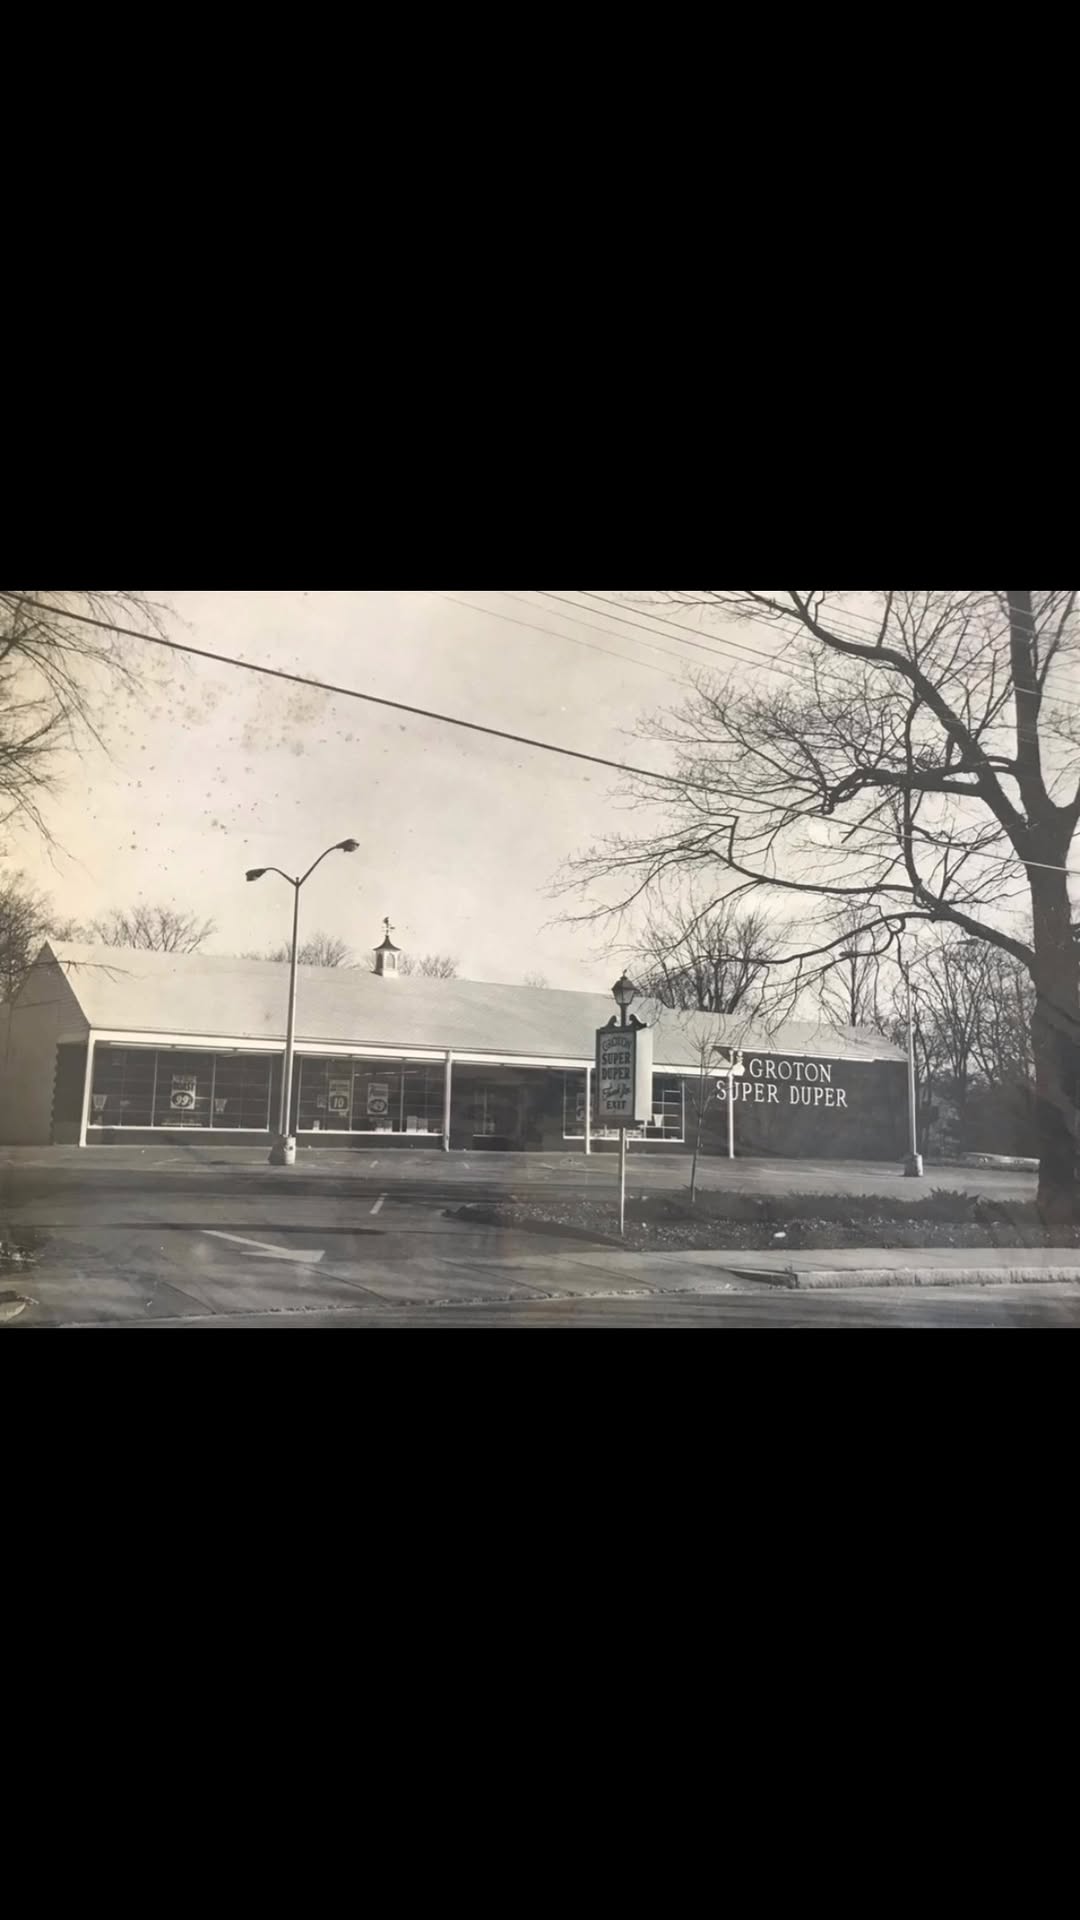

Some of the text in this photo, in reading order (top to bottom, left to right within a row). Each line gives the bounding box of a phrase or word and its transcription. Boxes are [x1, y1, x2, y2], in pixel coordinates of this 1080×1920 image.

[602, 1052, 631, 1065] SUPER
[601, 1067, 631, 1080] DUPER
[749, 1058, 832, 1083] GROTON
[716, 1080, 848, 1107] SUPER DUPER
[606, 1100, 627, 1110] EXIT
